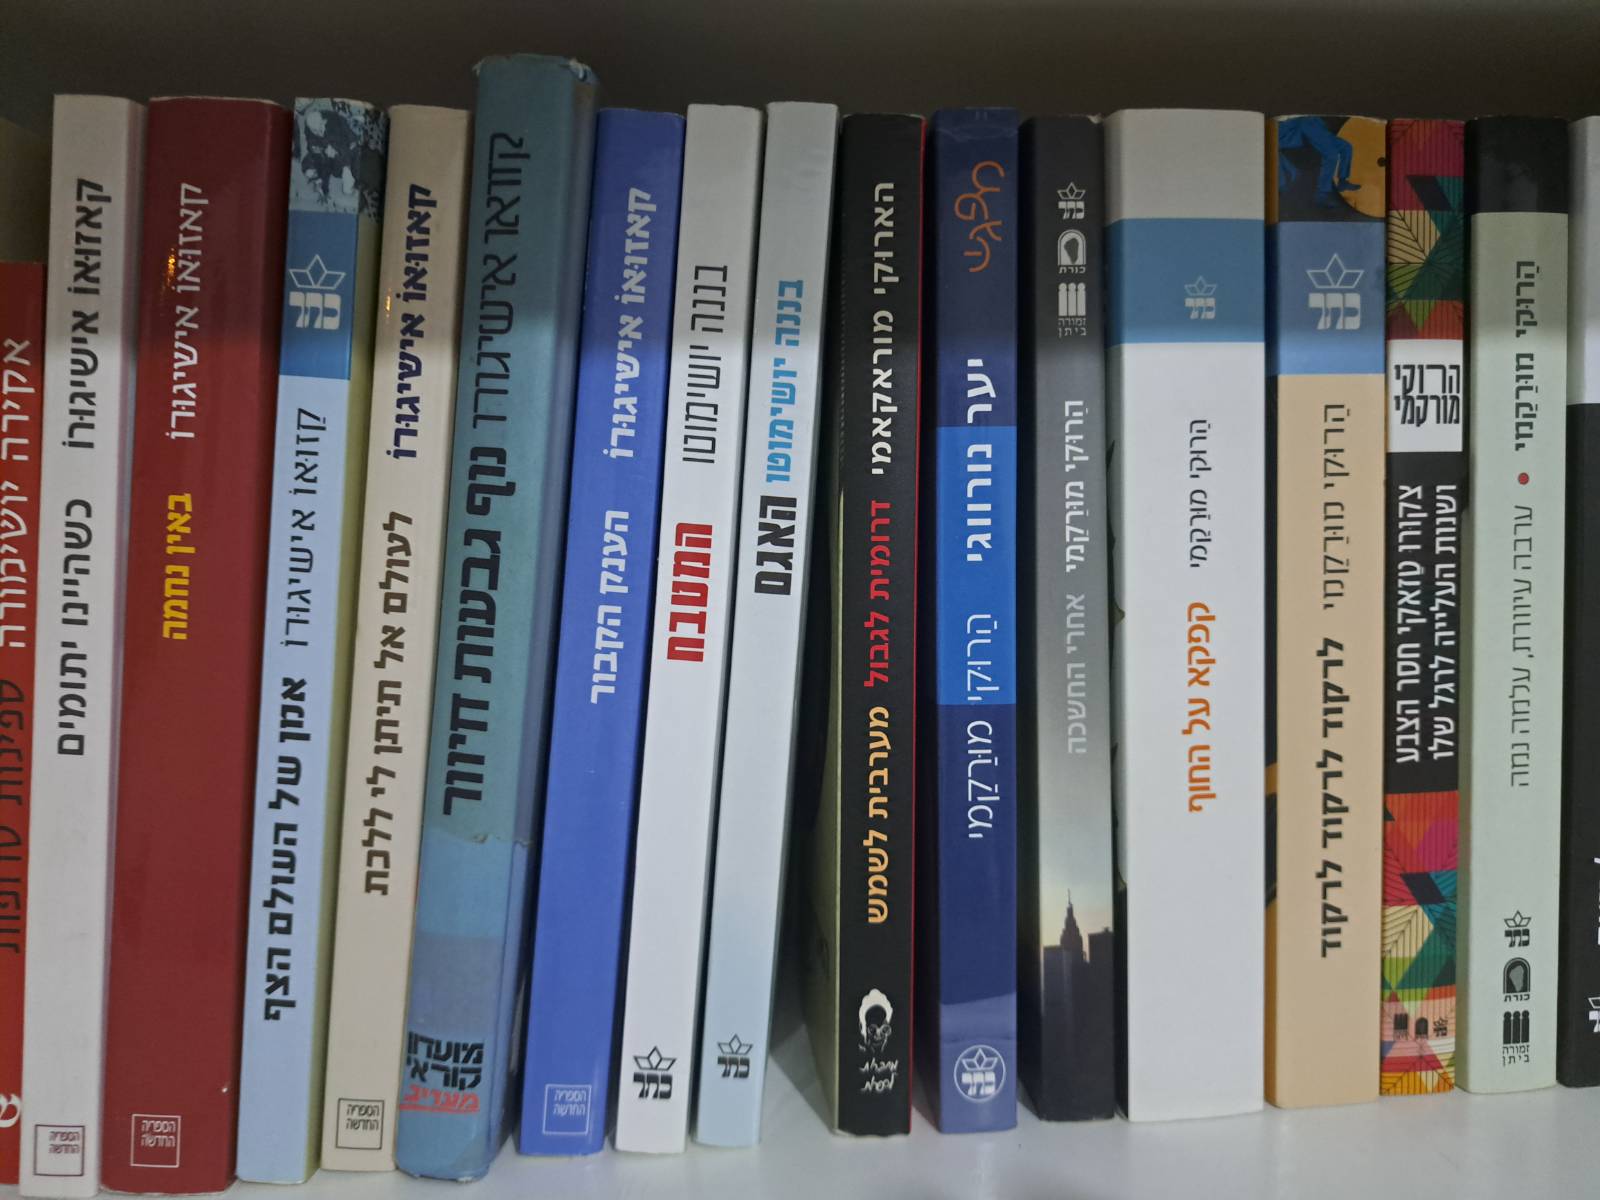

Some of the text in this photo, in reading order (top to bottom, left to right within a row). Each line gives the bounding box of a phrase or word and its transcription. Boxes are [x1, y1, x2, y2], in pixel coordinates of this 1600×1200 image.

[472, 254, 517, 429] אישיגורו
[1394, 364, 1460, 397] הרוקי
[1, 338, 35, 461] אקירה
[870, 310, 898, 475] מוראקאמי
[966, 358, 996, 424] יער
[1394, 395, 1460, 427] מורקמי
[666, 265, 728, 663] בננה יושימוטו המטבח
[753, 279, 803, 596] בננה יושימוטו האגם
[165, 493, 195, 554] באין
[465, 447, 516, 516] נוף
[966, 443, 993, 562] נורווגי
[0, 481, 29, 647] יושימורה
[61, 499, 93, 626] כשהיינו
[378, 511, 413, 614] לעולם
[599, 510, 629, 595] הענק
[869, 500, 891, 601] דרומית
[1513, 505, 1532, 570] ערבה
[162, 564, 190, 640] נחמה
[453, 528, 502, 684] גבעות
[1065, 593, 1086, 654] אחרי
[1186, 602, 1216, 687] קפקא
[1428, 484, 1457, 760] ושנות העלייה לרגל שלו
[1512, 579, 1534, 659] עיוורת,
[373, 625, 406, 669] אל
[590, 605, 624, 704] הקבור
[863, 611, 890, 688] לגבול
[1316, 637, 1350, 738] לרקוד
[1396, 643, 1421, 691] חסר
[57, 641, 87, 756] יתומים
[278, 677, 311, 743] אמן
[373, 680, 404, 755] תיתן
[1065, 662, 1088, 754] החשכה
[1182, 698, 1210, 735] על
[1396, 700, 1421, 764] הצבע
[1509, 667, 1531, 734] עלמה
[268, 756, 301, 810] של
[366, 765, 396, 798] לי
[441, 693, 489, 816] חיוור
[867, 706, 892, 819] מערבית
[1186, 745, 1216, 813] החוף
[1510, 743, 1530, 787] נמה
[1315, 749, 1349, 849] לרקוד
[262, 822, 298, 935] העולם
[361, 808, 393, 896] ללכת
[862, 829, 889, 924] לשמש
[1315, 859, 1348, 958] לרקוד
[263, 947, 296, 1021] הצף
[407, 1031, 484, 1064] מועדון
[403, 1084, 480, 1108] מעריב
